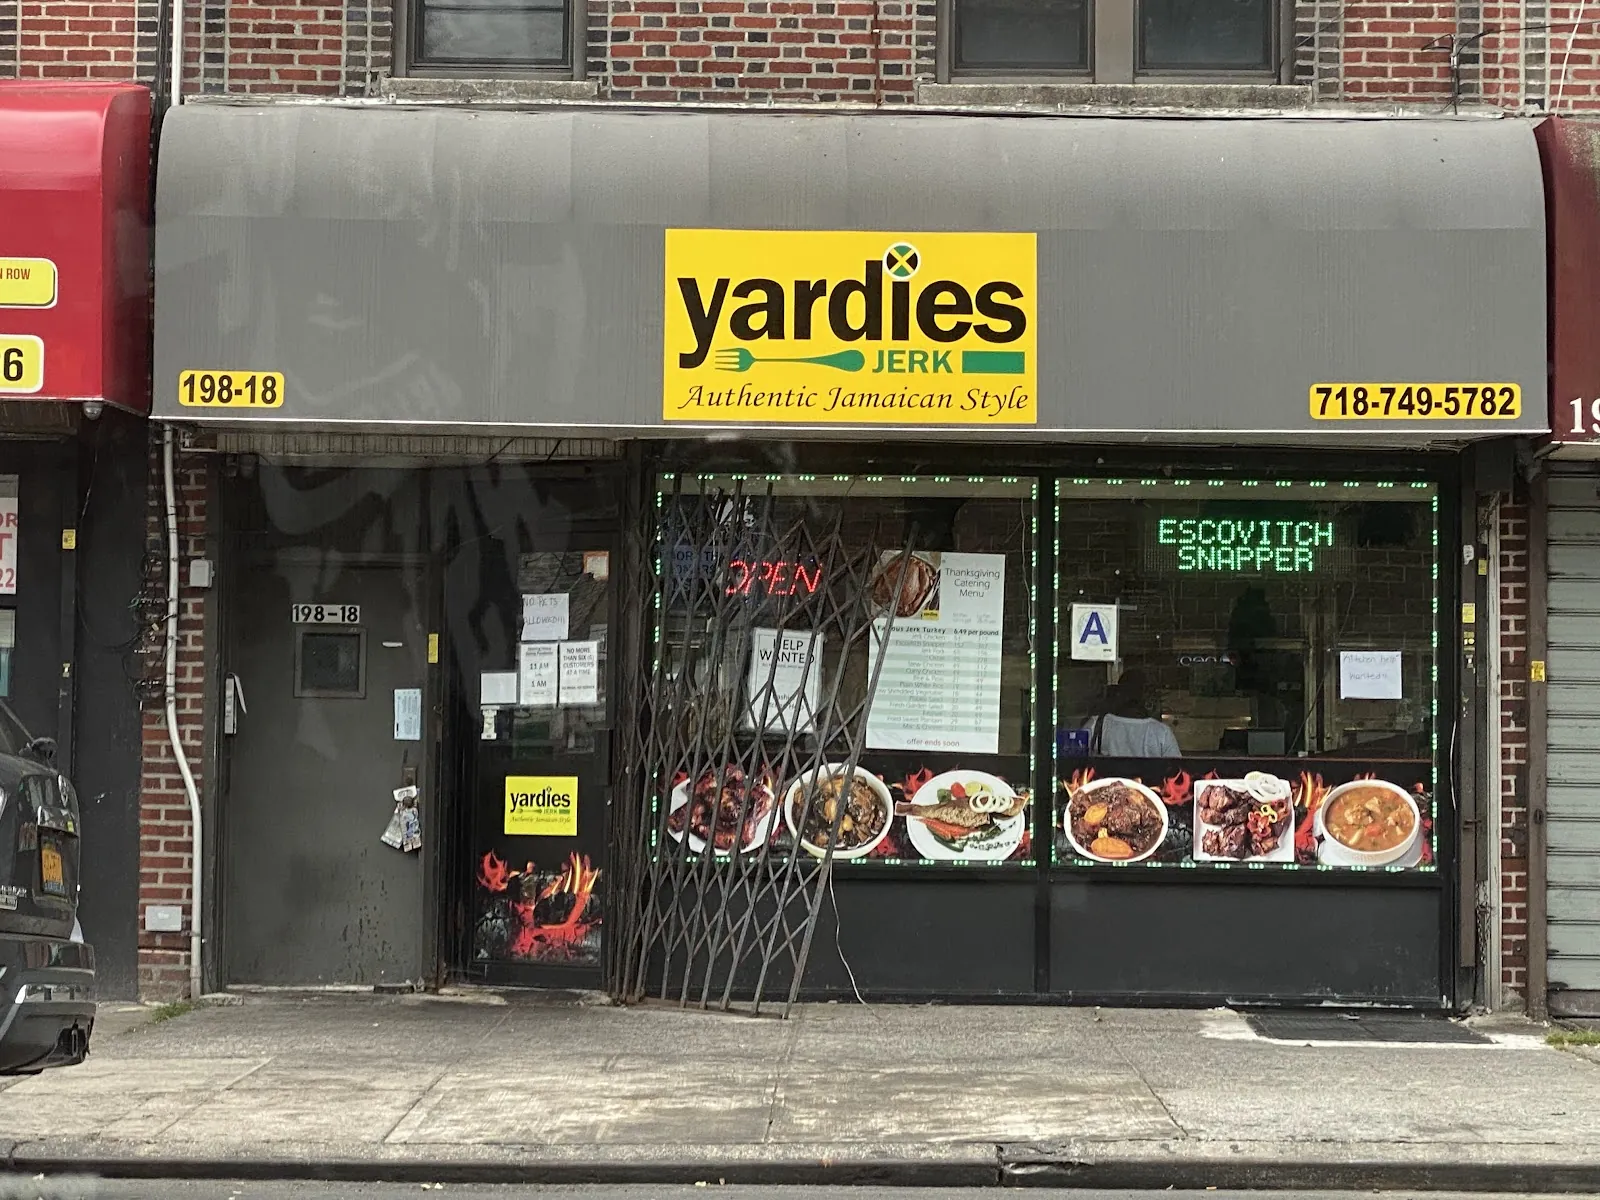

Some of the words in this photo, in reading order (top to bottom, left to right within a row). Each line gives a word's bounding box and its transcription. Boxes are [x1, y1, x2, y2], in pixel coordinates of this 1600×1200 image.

[6, 268, 30, 280] ROW
[677, 243, 1027, 368] yardies
[872, 350, 953, 374] JERK
[184, 374, 276, 404] 198-18
[677, 383, 819, 410] Authentic
[824, 386, 953, 411] Jamaican
[960, 386, 1028, 417] Style
[1316, 387, 1516, 416] 718-749-5782
[1159, 519, 1333, 546] ESCOVITCH
[1178, 546, 1313, 572] SNAPPER
[726, 560, 822, 596] OPEN
[945, 567, 1000, 580] Thanksgiving
[954, 578, 990, 590] Catering
[960, 589, 985, 598] Menu
[293, 605, 359, 622] 198-18
[1079, 612, 1108, 644] A
[760, 649, 815, 664] WNTED
[510, 786, 571, 813] yardies
